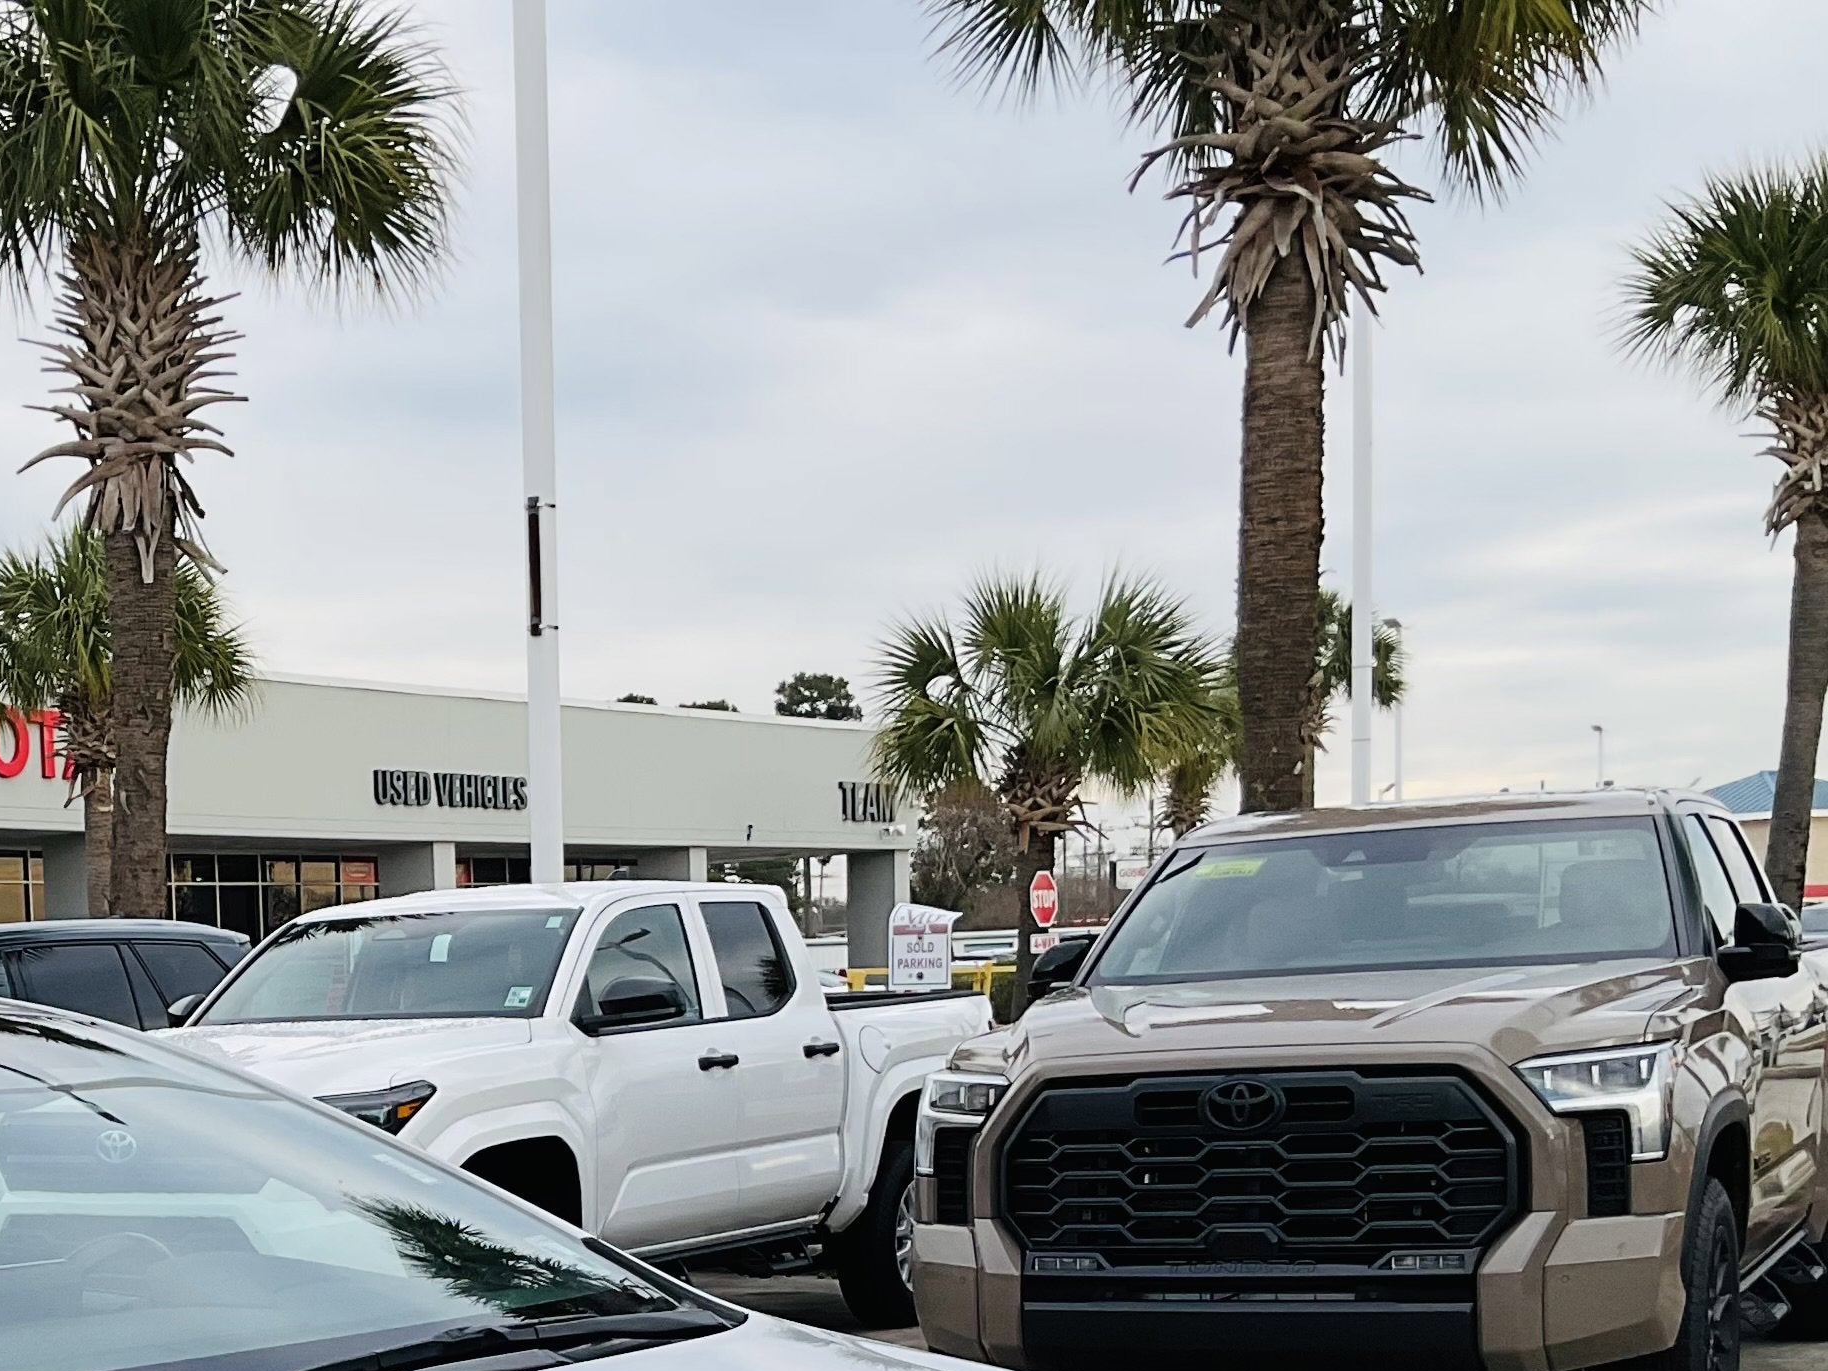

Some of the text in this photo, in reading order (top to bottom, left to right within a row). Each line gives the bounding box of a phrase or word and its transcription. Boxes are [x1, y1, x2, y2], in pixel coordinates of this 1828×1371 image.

[373, 770, 527, 811] USED VEHICLES
[838, 781, 896, 823] TEAM
[1033, 889, 1055, 909] STOP
[906, 941, 935, 954] SOLD
[897, 958, 943, 970] PARKING
